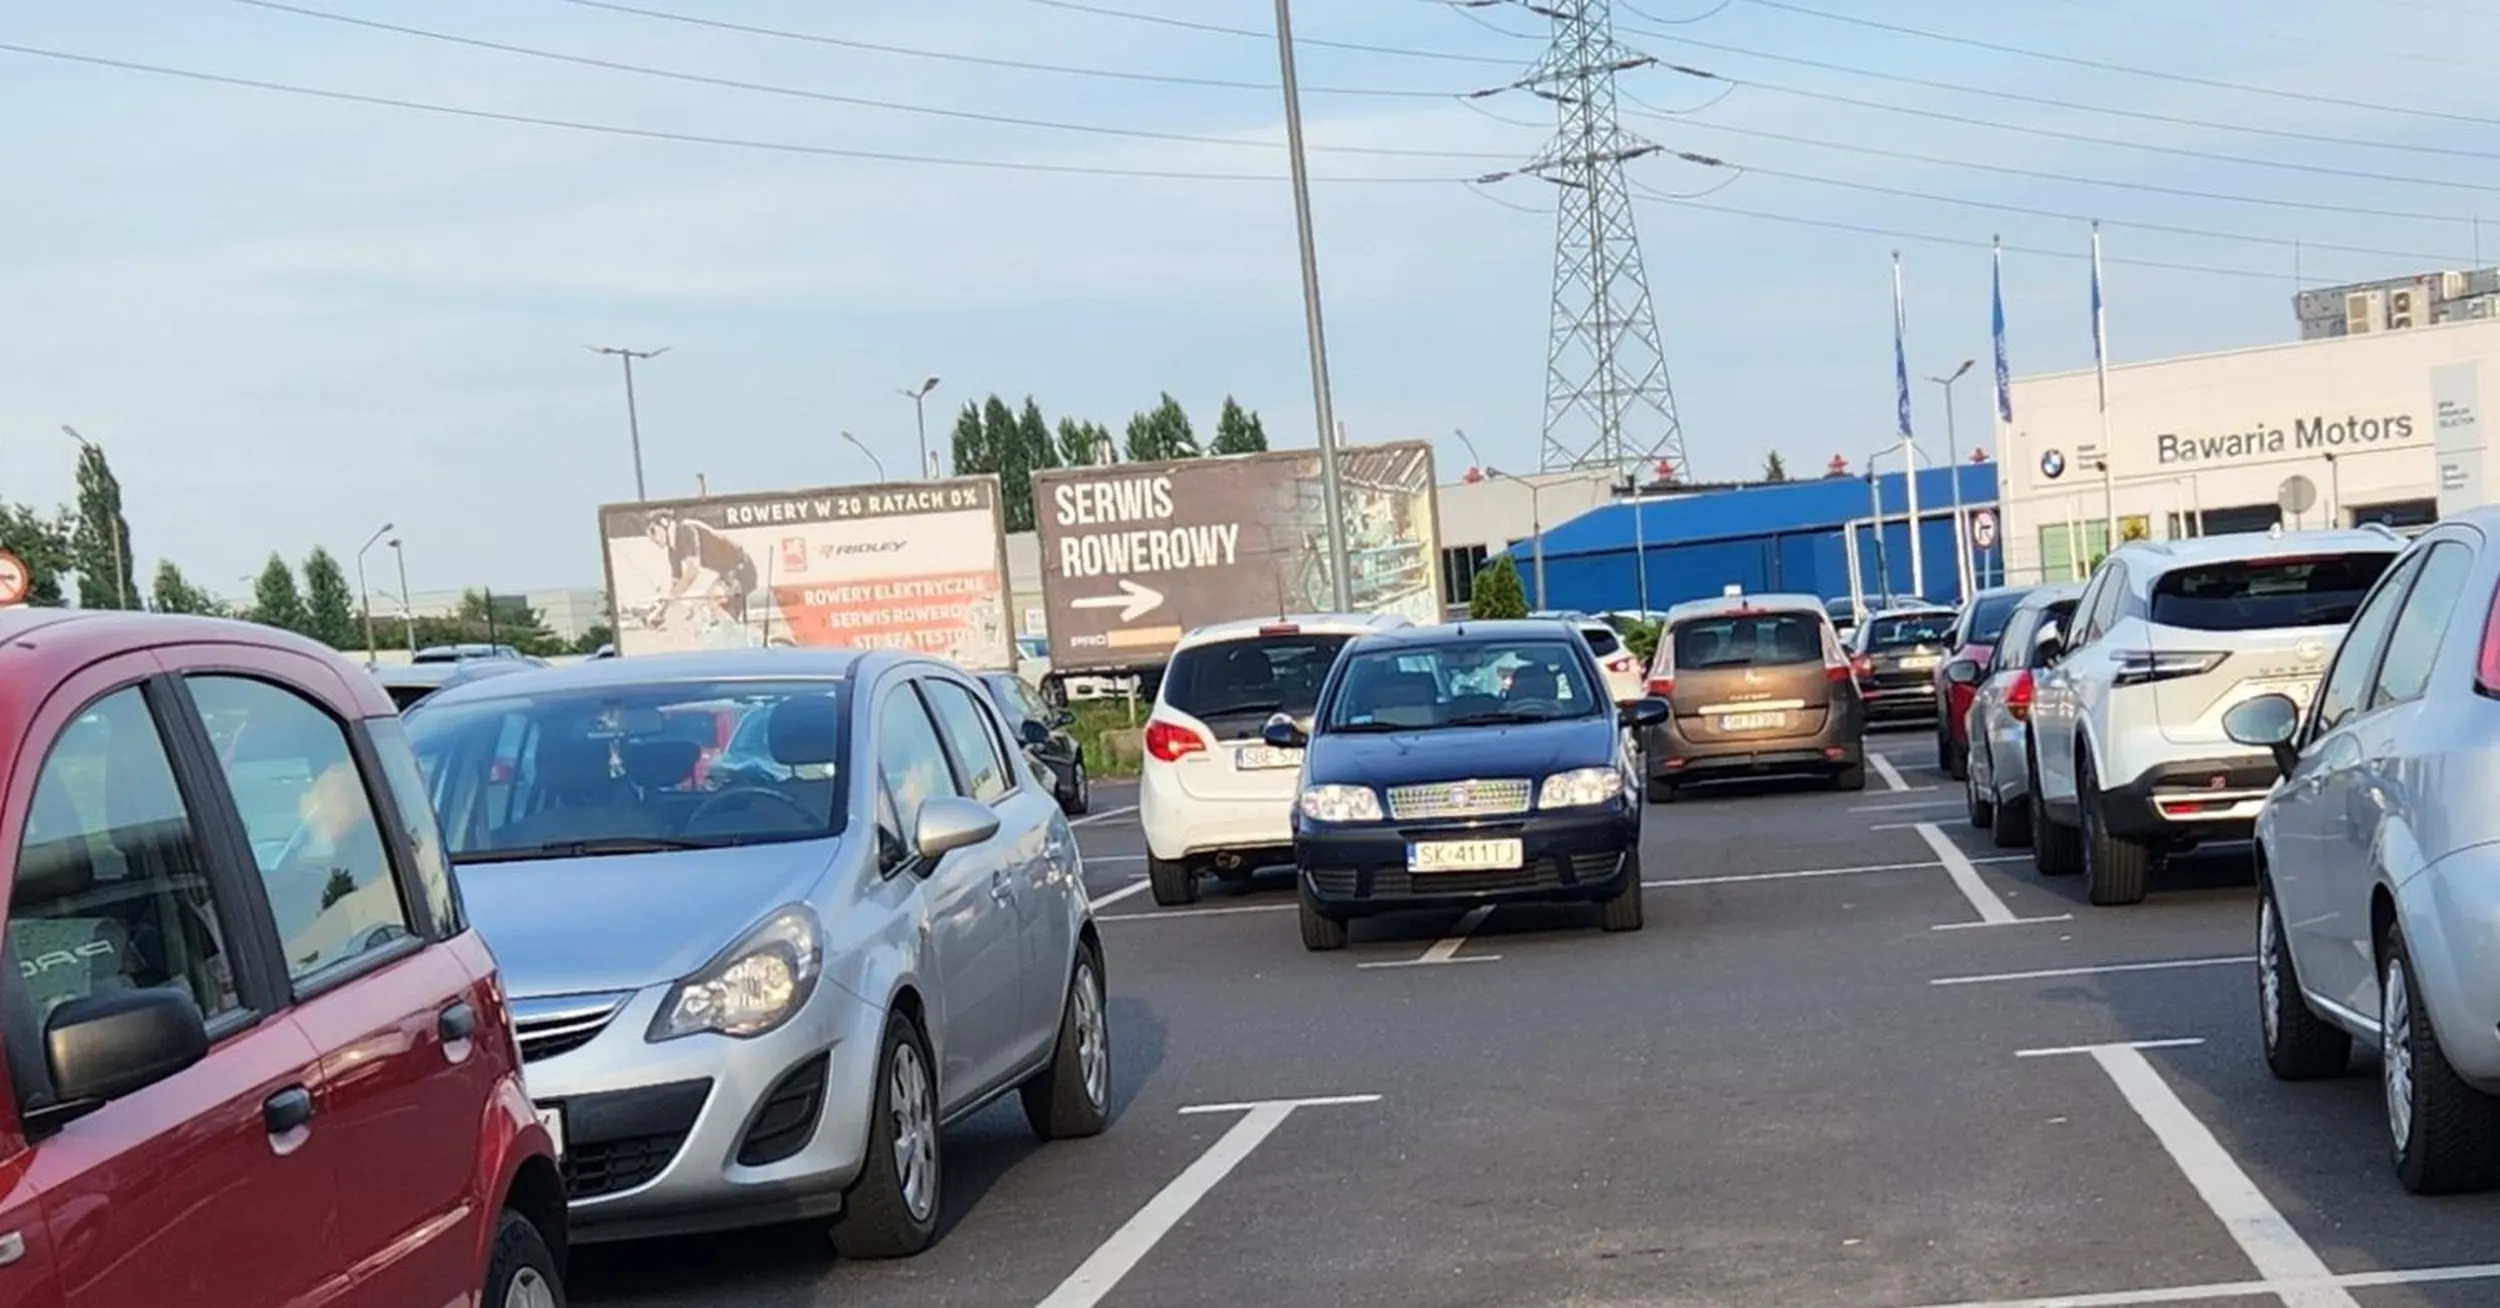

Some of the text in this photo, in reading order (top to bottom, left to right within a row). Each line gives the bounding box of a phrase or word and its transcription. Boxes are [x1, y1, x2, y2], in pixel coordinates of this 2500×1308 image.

[2157, 415, 2413, 464] Bawaria Motors
[727, 488, 977, 524] ROWERY W 20 RATACH 0%
[1055, 477, 1173, 526] SERWIS
[1060, 523, 1240, 577] ROWEROWY
[804, 576, 986, 606] ROWERY ELEKTRYCZNE
[830, 609, 889, 629] SERWIS
[1420, 843, 1515, 865] SK 411TJ
